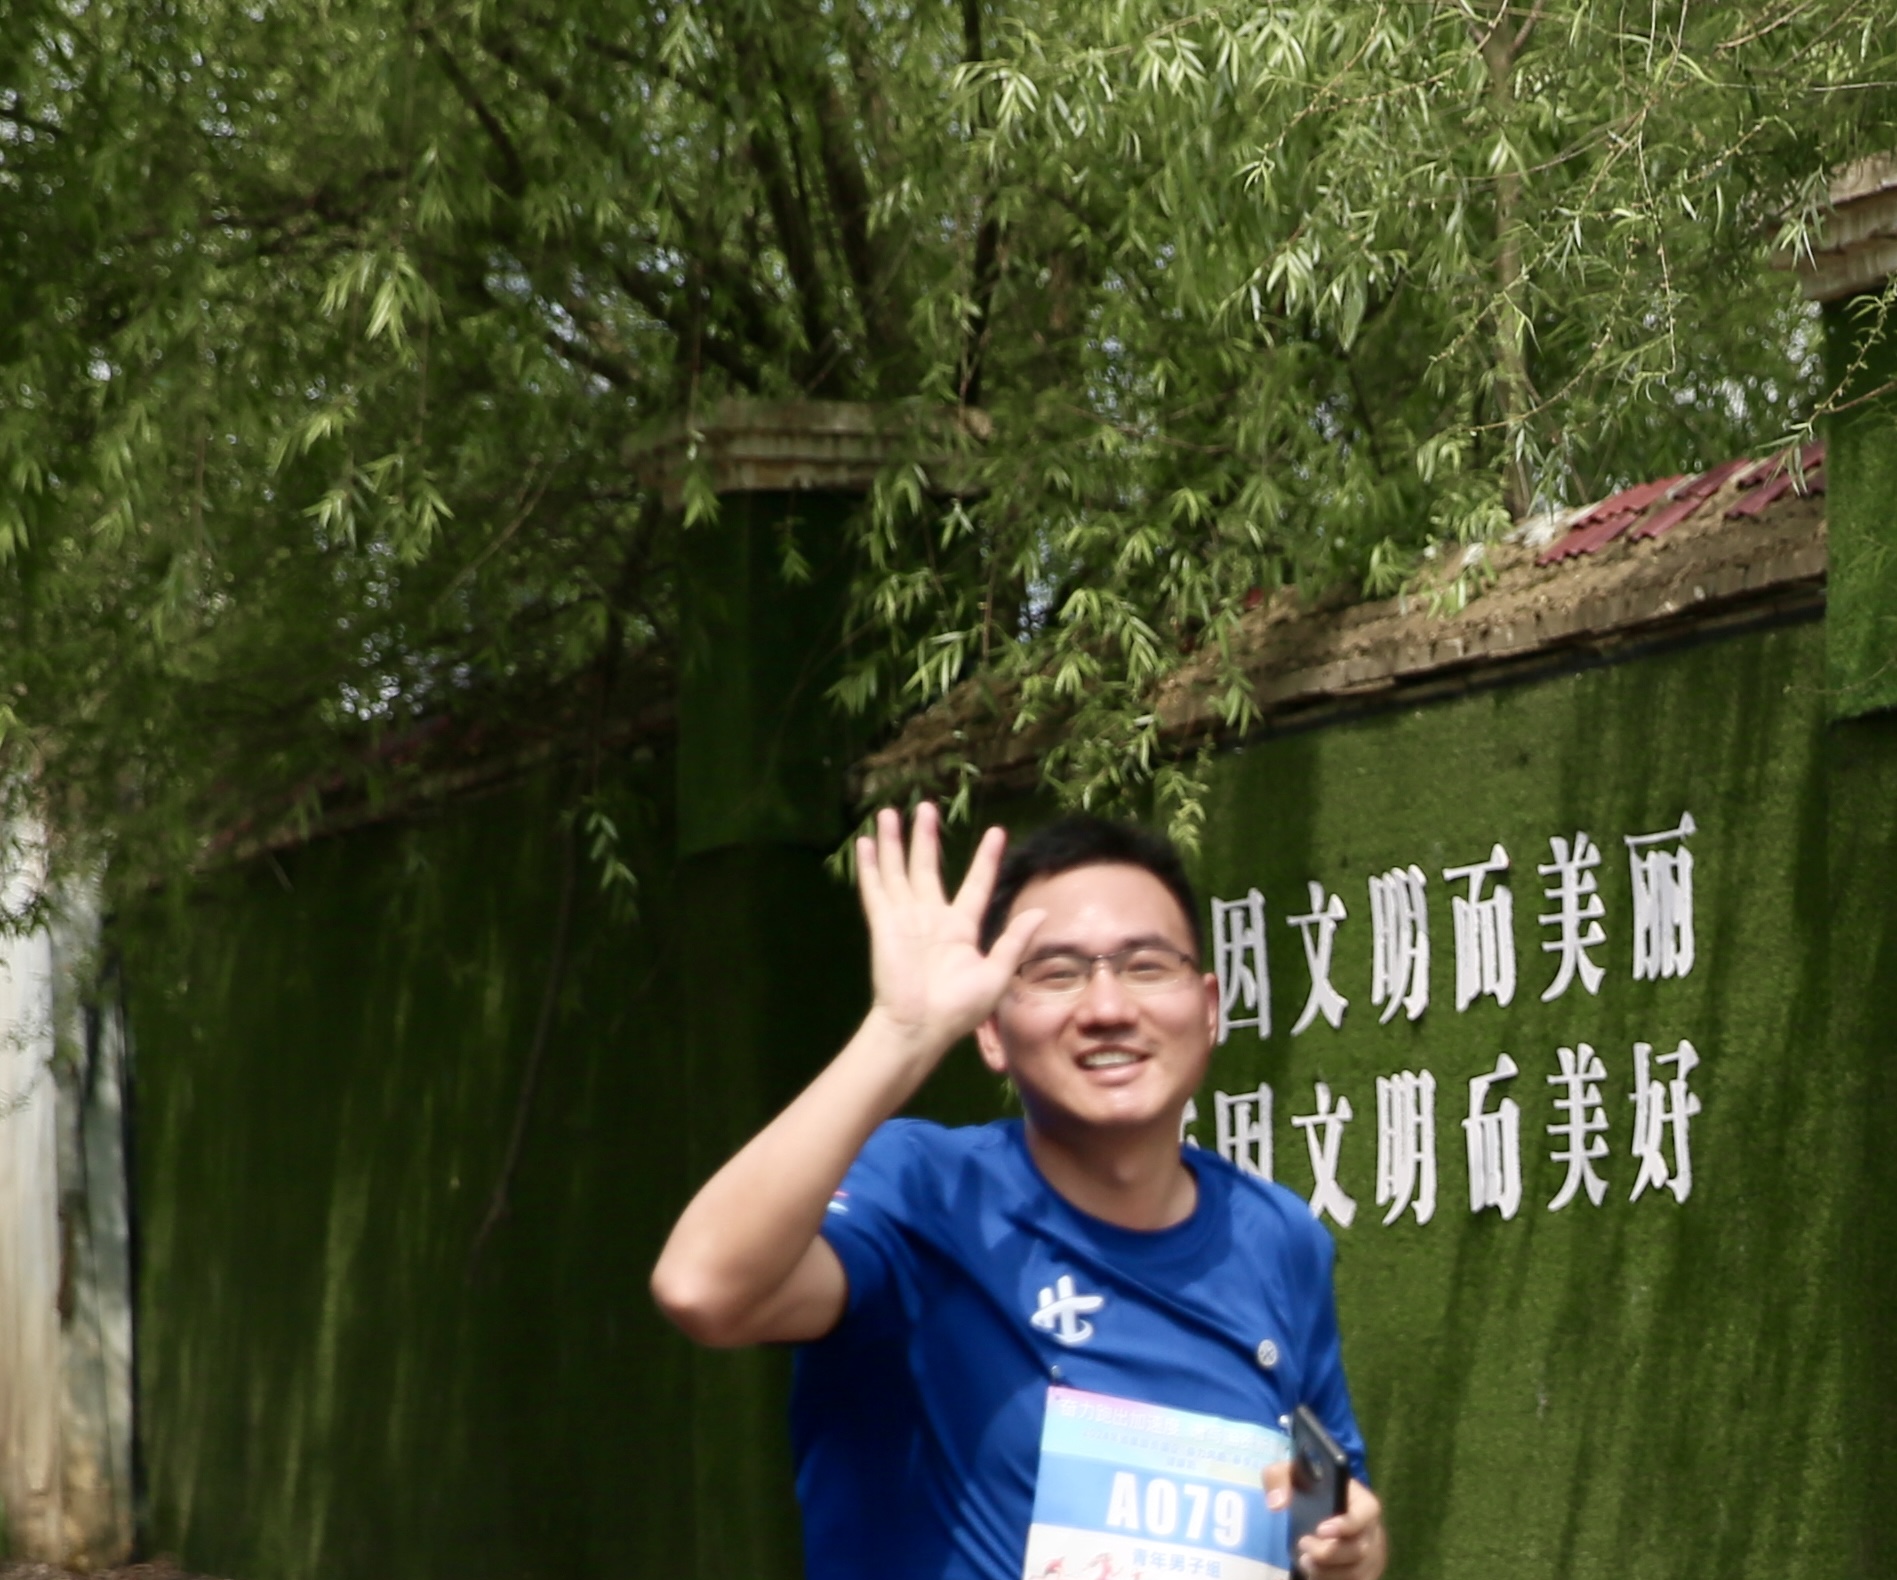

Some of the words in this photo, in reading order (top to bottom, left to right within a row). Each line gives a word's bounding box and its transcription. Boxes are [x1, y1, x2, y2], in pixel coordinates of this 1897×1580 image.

[1210, 811, 1697, 1045] 因文明而美丽
[1179, 1039, 1701, 1228] 因文明而美好
[1105, 1470, 1246, 1548] A079
[1132, 1547, 1222, 1579] 青年男子组
